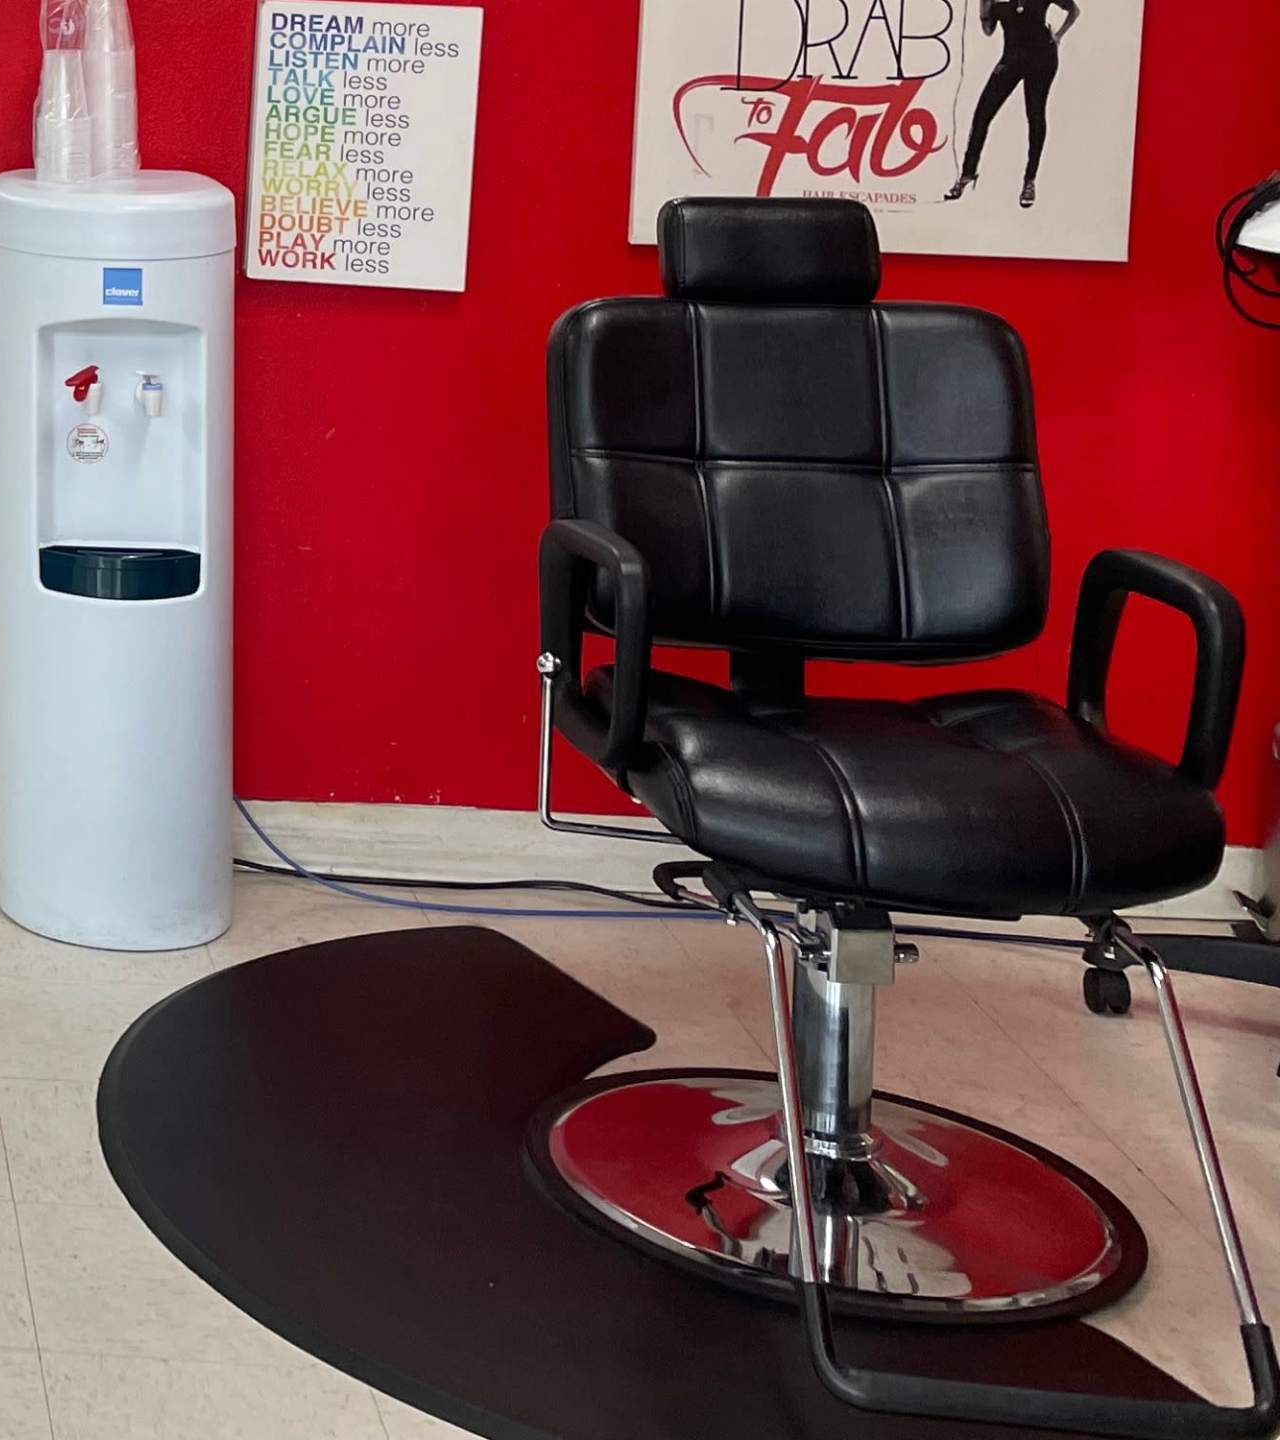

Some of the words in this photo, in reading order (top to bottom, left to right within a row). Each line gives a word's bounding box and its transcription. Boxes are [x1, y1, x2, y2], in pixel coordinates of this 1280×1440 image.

[272, 13, 363, 34] DREAM
[372, 21, 430, 37] more
[270, 32, 405, 54] COMPLAIN
[414, 38, 459, 58] less
[269, 50, 358, 70] LISTEN
[367, 58, 425, 74] more
[268, 68, 334, 88] TALK
[344, 71, 388, 91] less
[267, 86, 335, 106] LOVE
[343, 93, 400, 110] more
[265, 105, 356, 126] ARGUE
[365, 109, 410, 129] less
[265, 123, 335, 143] HOPE
[344, 130, 401, 146] more
[264, 141, 331, 160] FEAR
[340, 144, 384, 164] less
[263, 160, 348, 179] RELAX
[356, 167, 413, 184] more
[262, 177, 358, 198] WORRY
[367, 182, 411, 202] less
[261, 195, 368, 218] BELIEVE
[376, 205, 434, 221] more
[260, 213, 350, 235] DOUBT
[357, 219, 402, 238] less
[259, 231, 325, 251] PLAY
[333, 239, 390, 255] more
[258, 249, 336, 270] WORK
[345, 254, 389, 274] less
